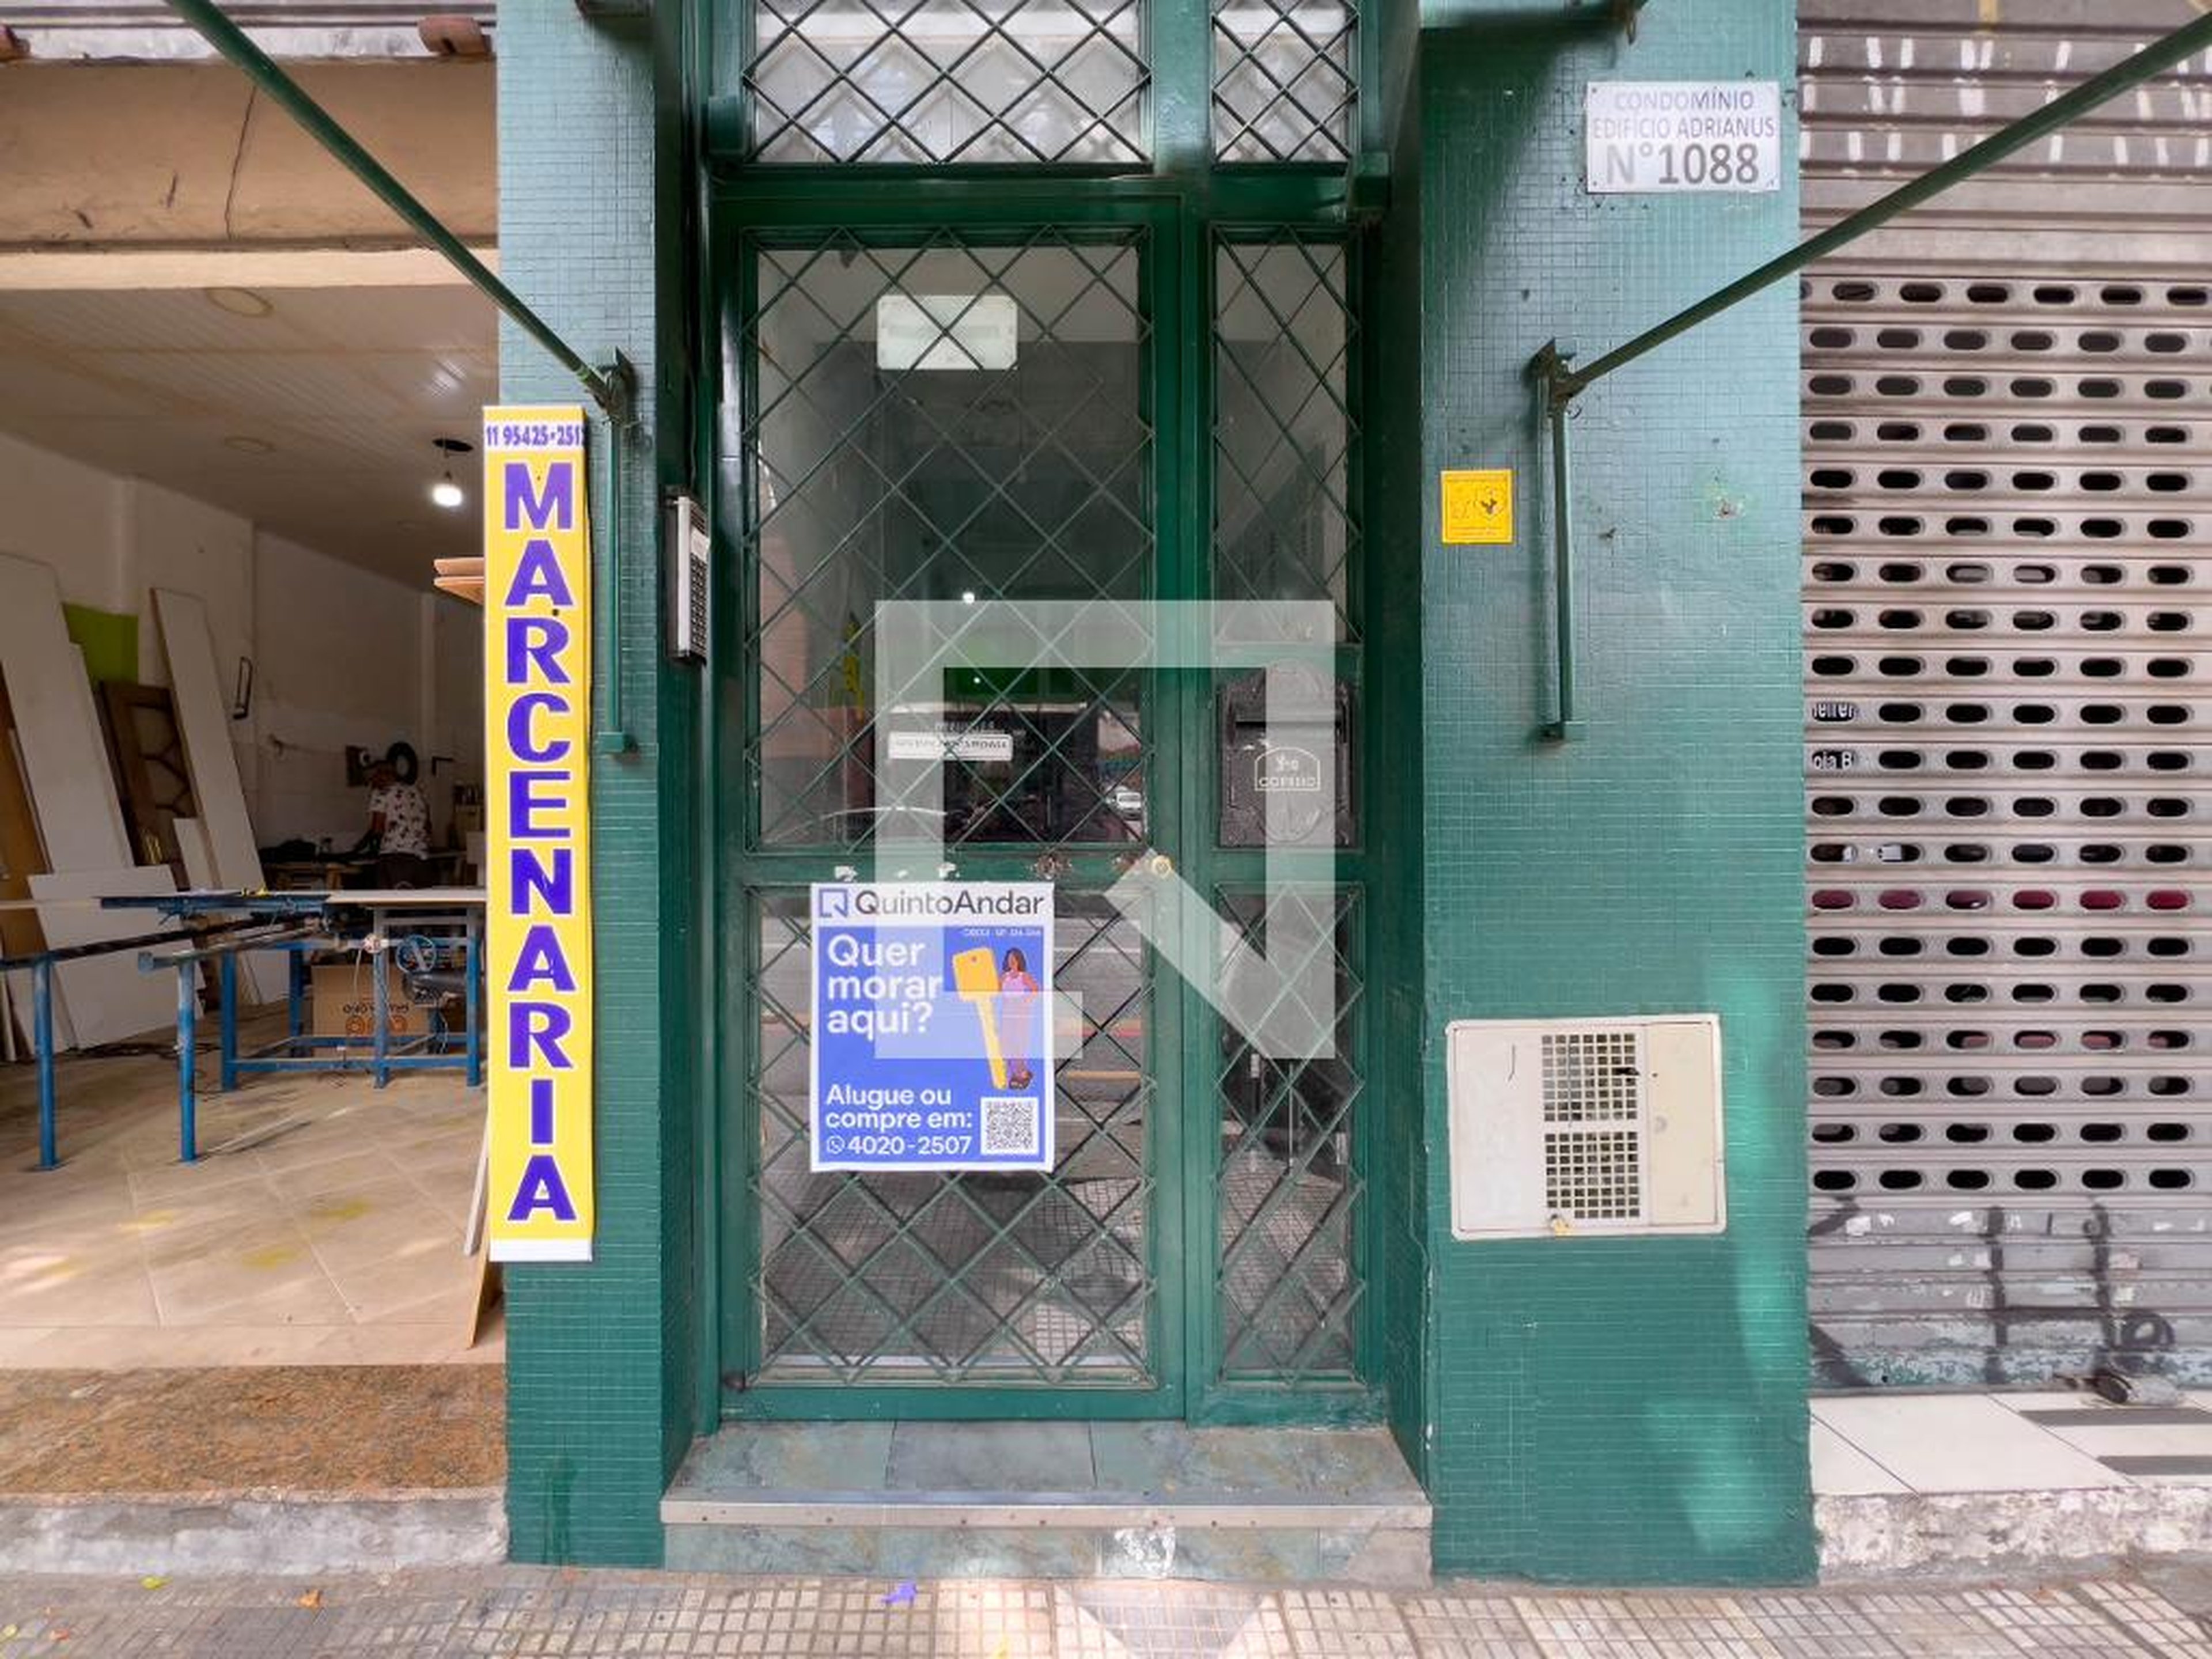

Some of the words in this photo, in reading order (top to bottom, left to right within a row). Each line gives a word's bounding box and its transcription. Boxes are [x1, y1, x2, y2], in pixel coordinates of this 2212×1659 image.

[1615, 86, 1755, 109] CONDOMÍNIO
[1677, 118, 1775, 138] ADRIANUS
[503, 425, 584, 445] 95425-251
[505, 463, 576, 1221] MARCENARIA
[855, 890, 1045, 916] QuintoAndar
[828, 934, 925, 967] Quer
[828, 975, 942, 999] morar
[828, 1002, 933, 1040] aqui?
[827, 1085, 914, 1109] Alugue
[921, 1089, 951, 1105] ou
[826, 1111, 921, 1132] compre
[927, 1112, 972, 1128] em:
